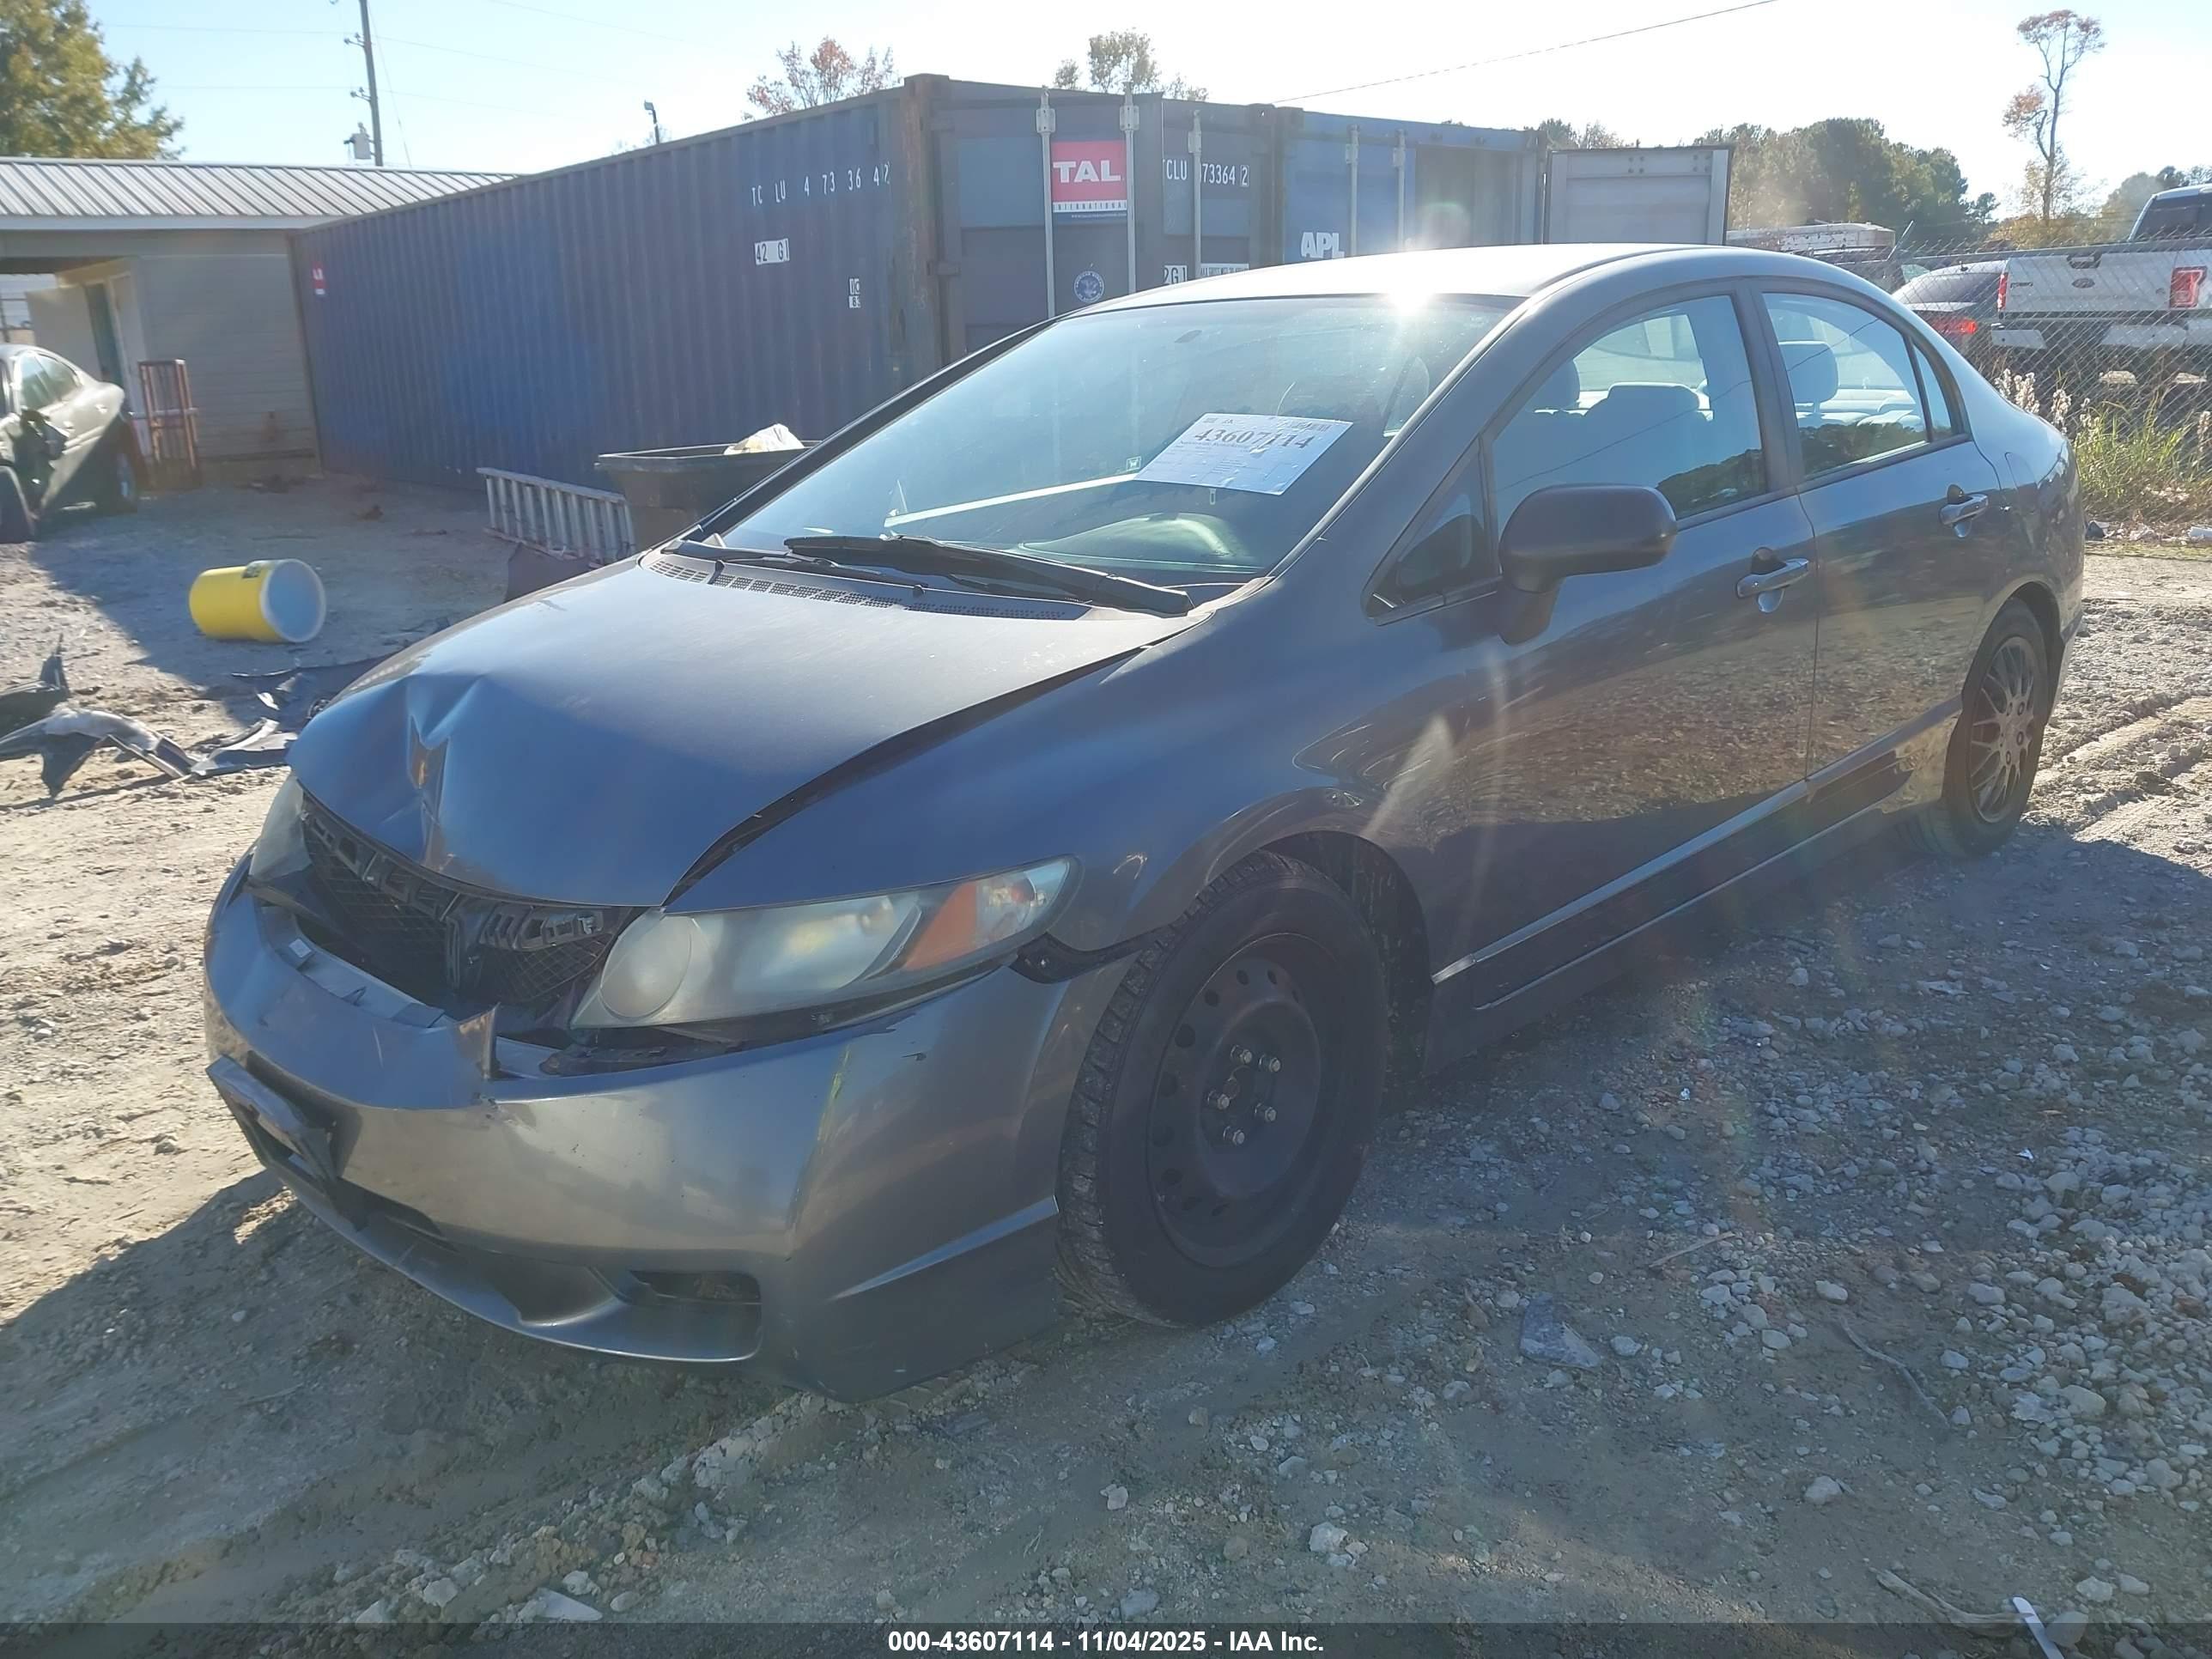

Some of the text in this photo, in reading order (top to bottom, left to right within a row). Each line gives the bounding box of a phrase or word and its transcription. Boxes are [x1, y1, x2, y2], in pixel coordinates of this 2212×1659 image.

[1053, 160, 1121, 183] TAL
[1163, 159, 1188, 181] CLU
[1300, 231, 1346, 258] APL
[1194, 428, 1316, 449] 43607114
